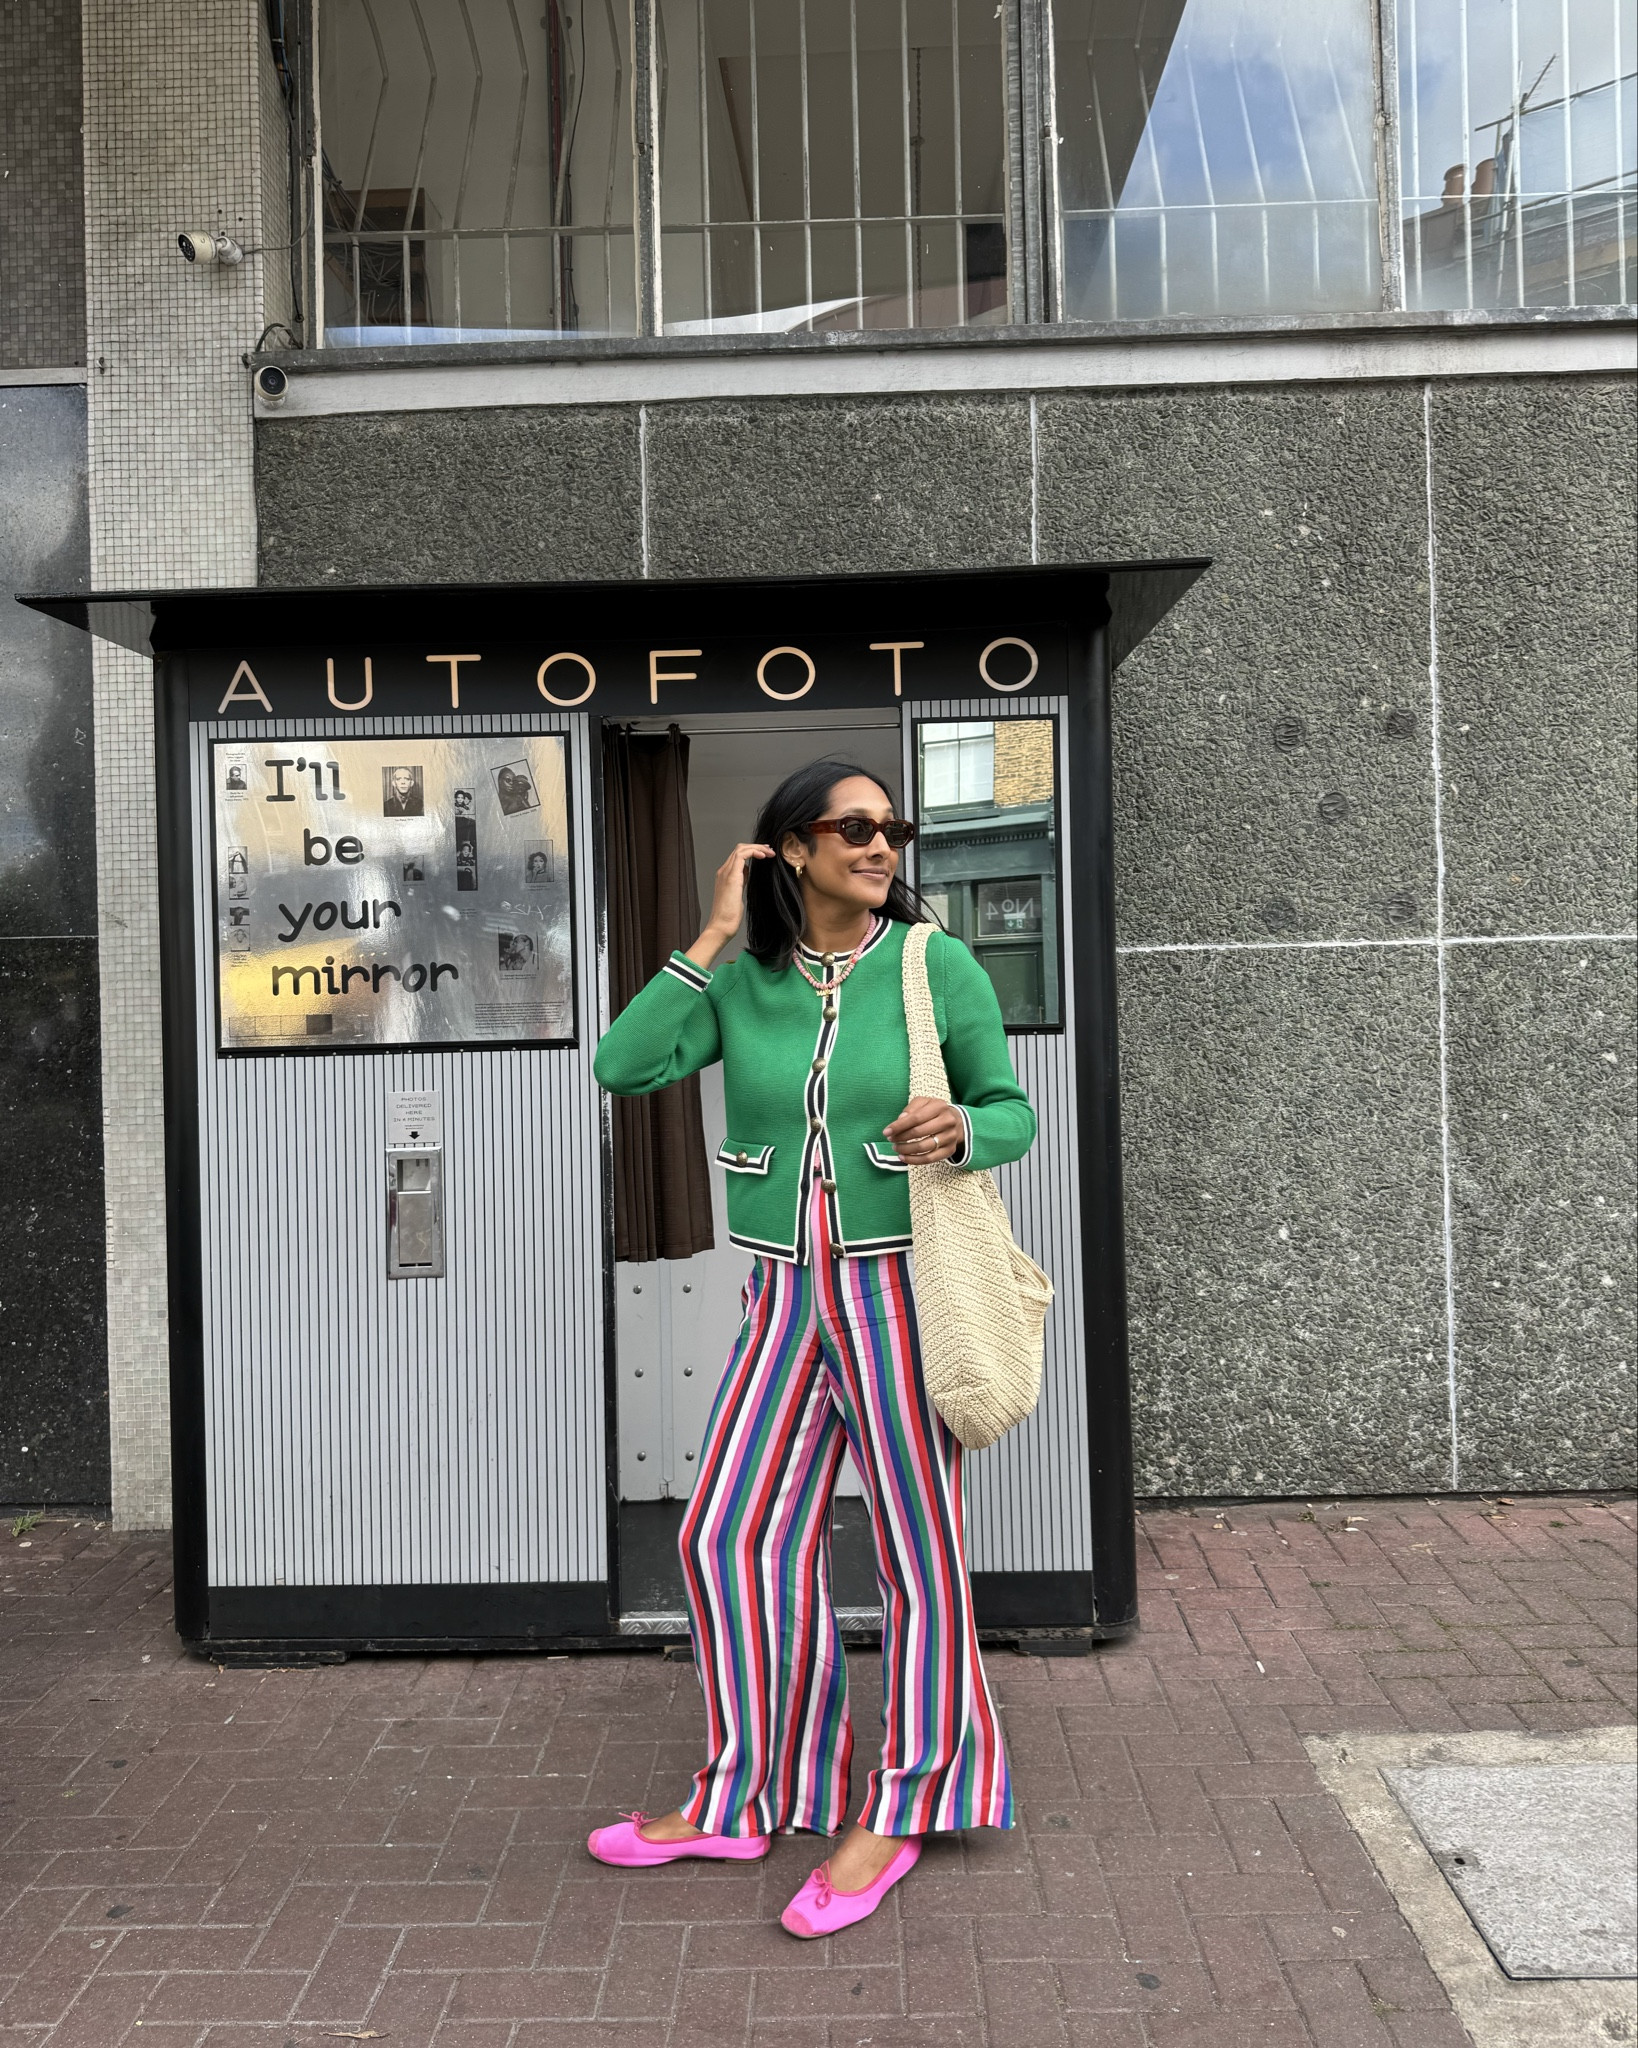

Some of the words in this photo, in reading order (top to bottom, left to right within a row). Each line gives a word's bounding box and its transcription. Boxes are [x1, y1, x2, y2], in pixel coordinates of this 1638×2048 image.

[218, 636, 1039, 714] AUTOFOTO
[265, 757, 346, 802] I'll
[303, 828, 365, 866] be
[278, 898, 402, 942] your
[272, 955, 459, 996] mirror
